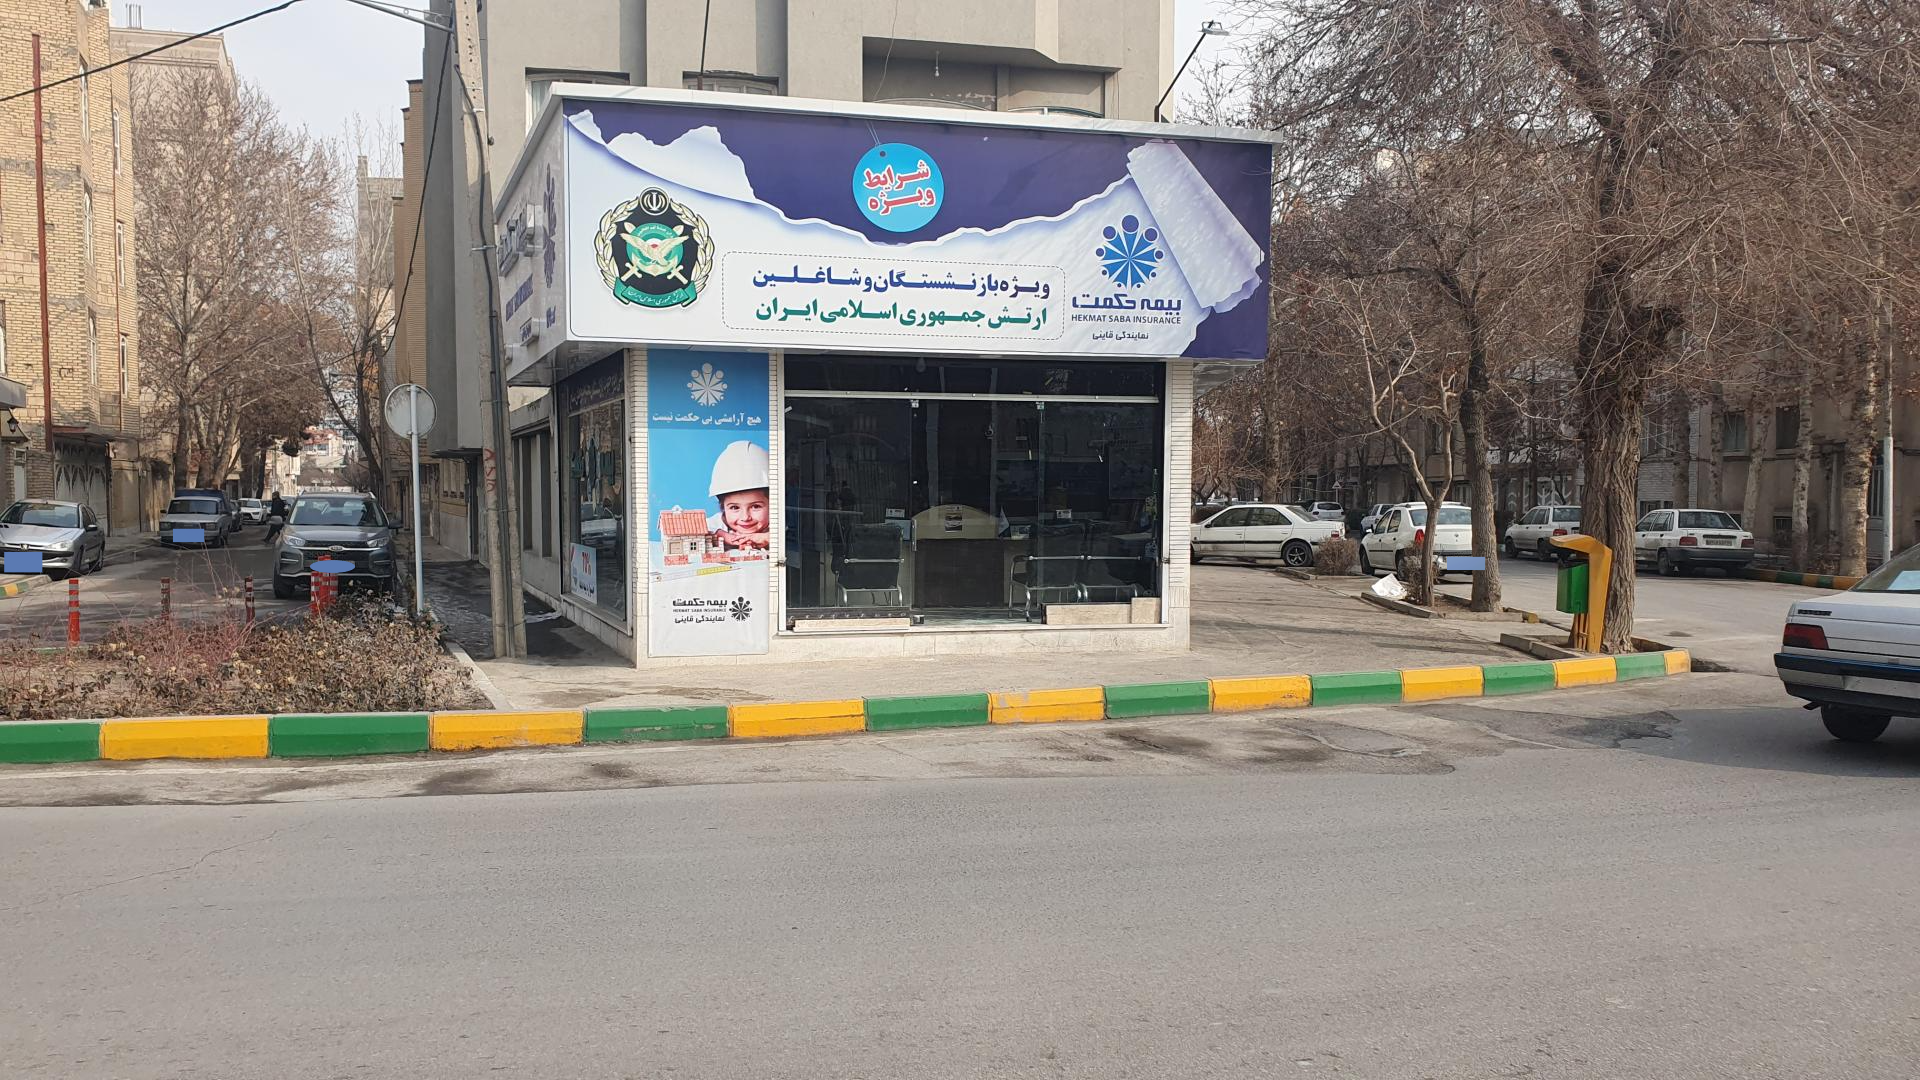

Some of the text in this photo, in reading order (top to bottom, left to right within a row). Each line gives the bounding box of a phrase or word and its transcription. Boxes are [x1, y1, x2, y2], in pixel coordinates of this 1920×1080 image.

[864, 160, 931, 190] شرایط
[868, 188, 935, 215] ویژه
[752, 265, 1051, 299] ویژه بازنشستگان و شاغلین
[1072, 293, 1182, 316] بیمه حکمت
[755, 296, 1048, 331] ارتش جمهوری اسلامی ایران
[1072, 314, 1181, 325] HEKMAT SABA INSURANCE
[1115, 331, 1149, 341] نمایندگی
[652, 411, 673, 423] نیست
[675, 412, 700, 422] حکمت
[701, 416, 713, 425] بی
[746, 415, 762, 426] هیچ
[673, 598, 704, 606] حکمت
[696, 616, 725, 624] نمایندگی
